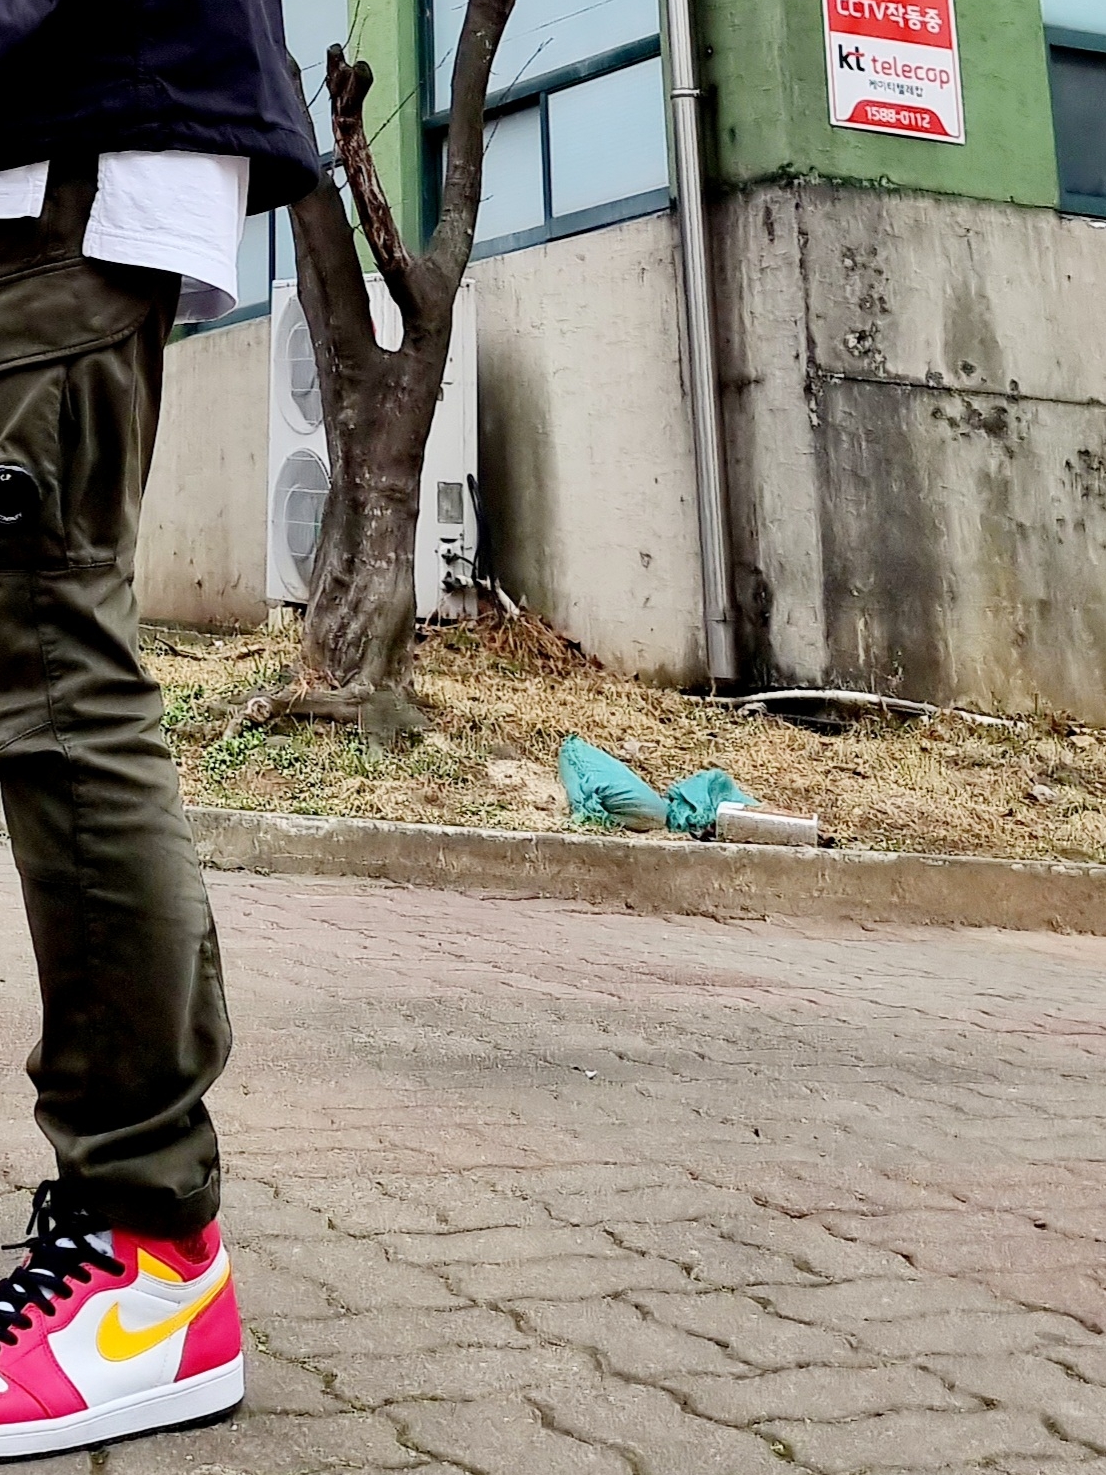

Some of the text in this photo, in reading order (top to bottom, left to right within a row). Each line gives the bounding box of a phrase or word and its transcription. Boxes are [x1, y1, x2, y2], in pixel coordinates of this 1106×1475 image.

[838, 43, 951, 90] kt telecop
[865, 105, 931, 129] 1588-0112
